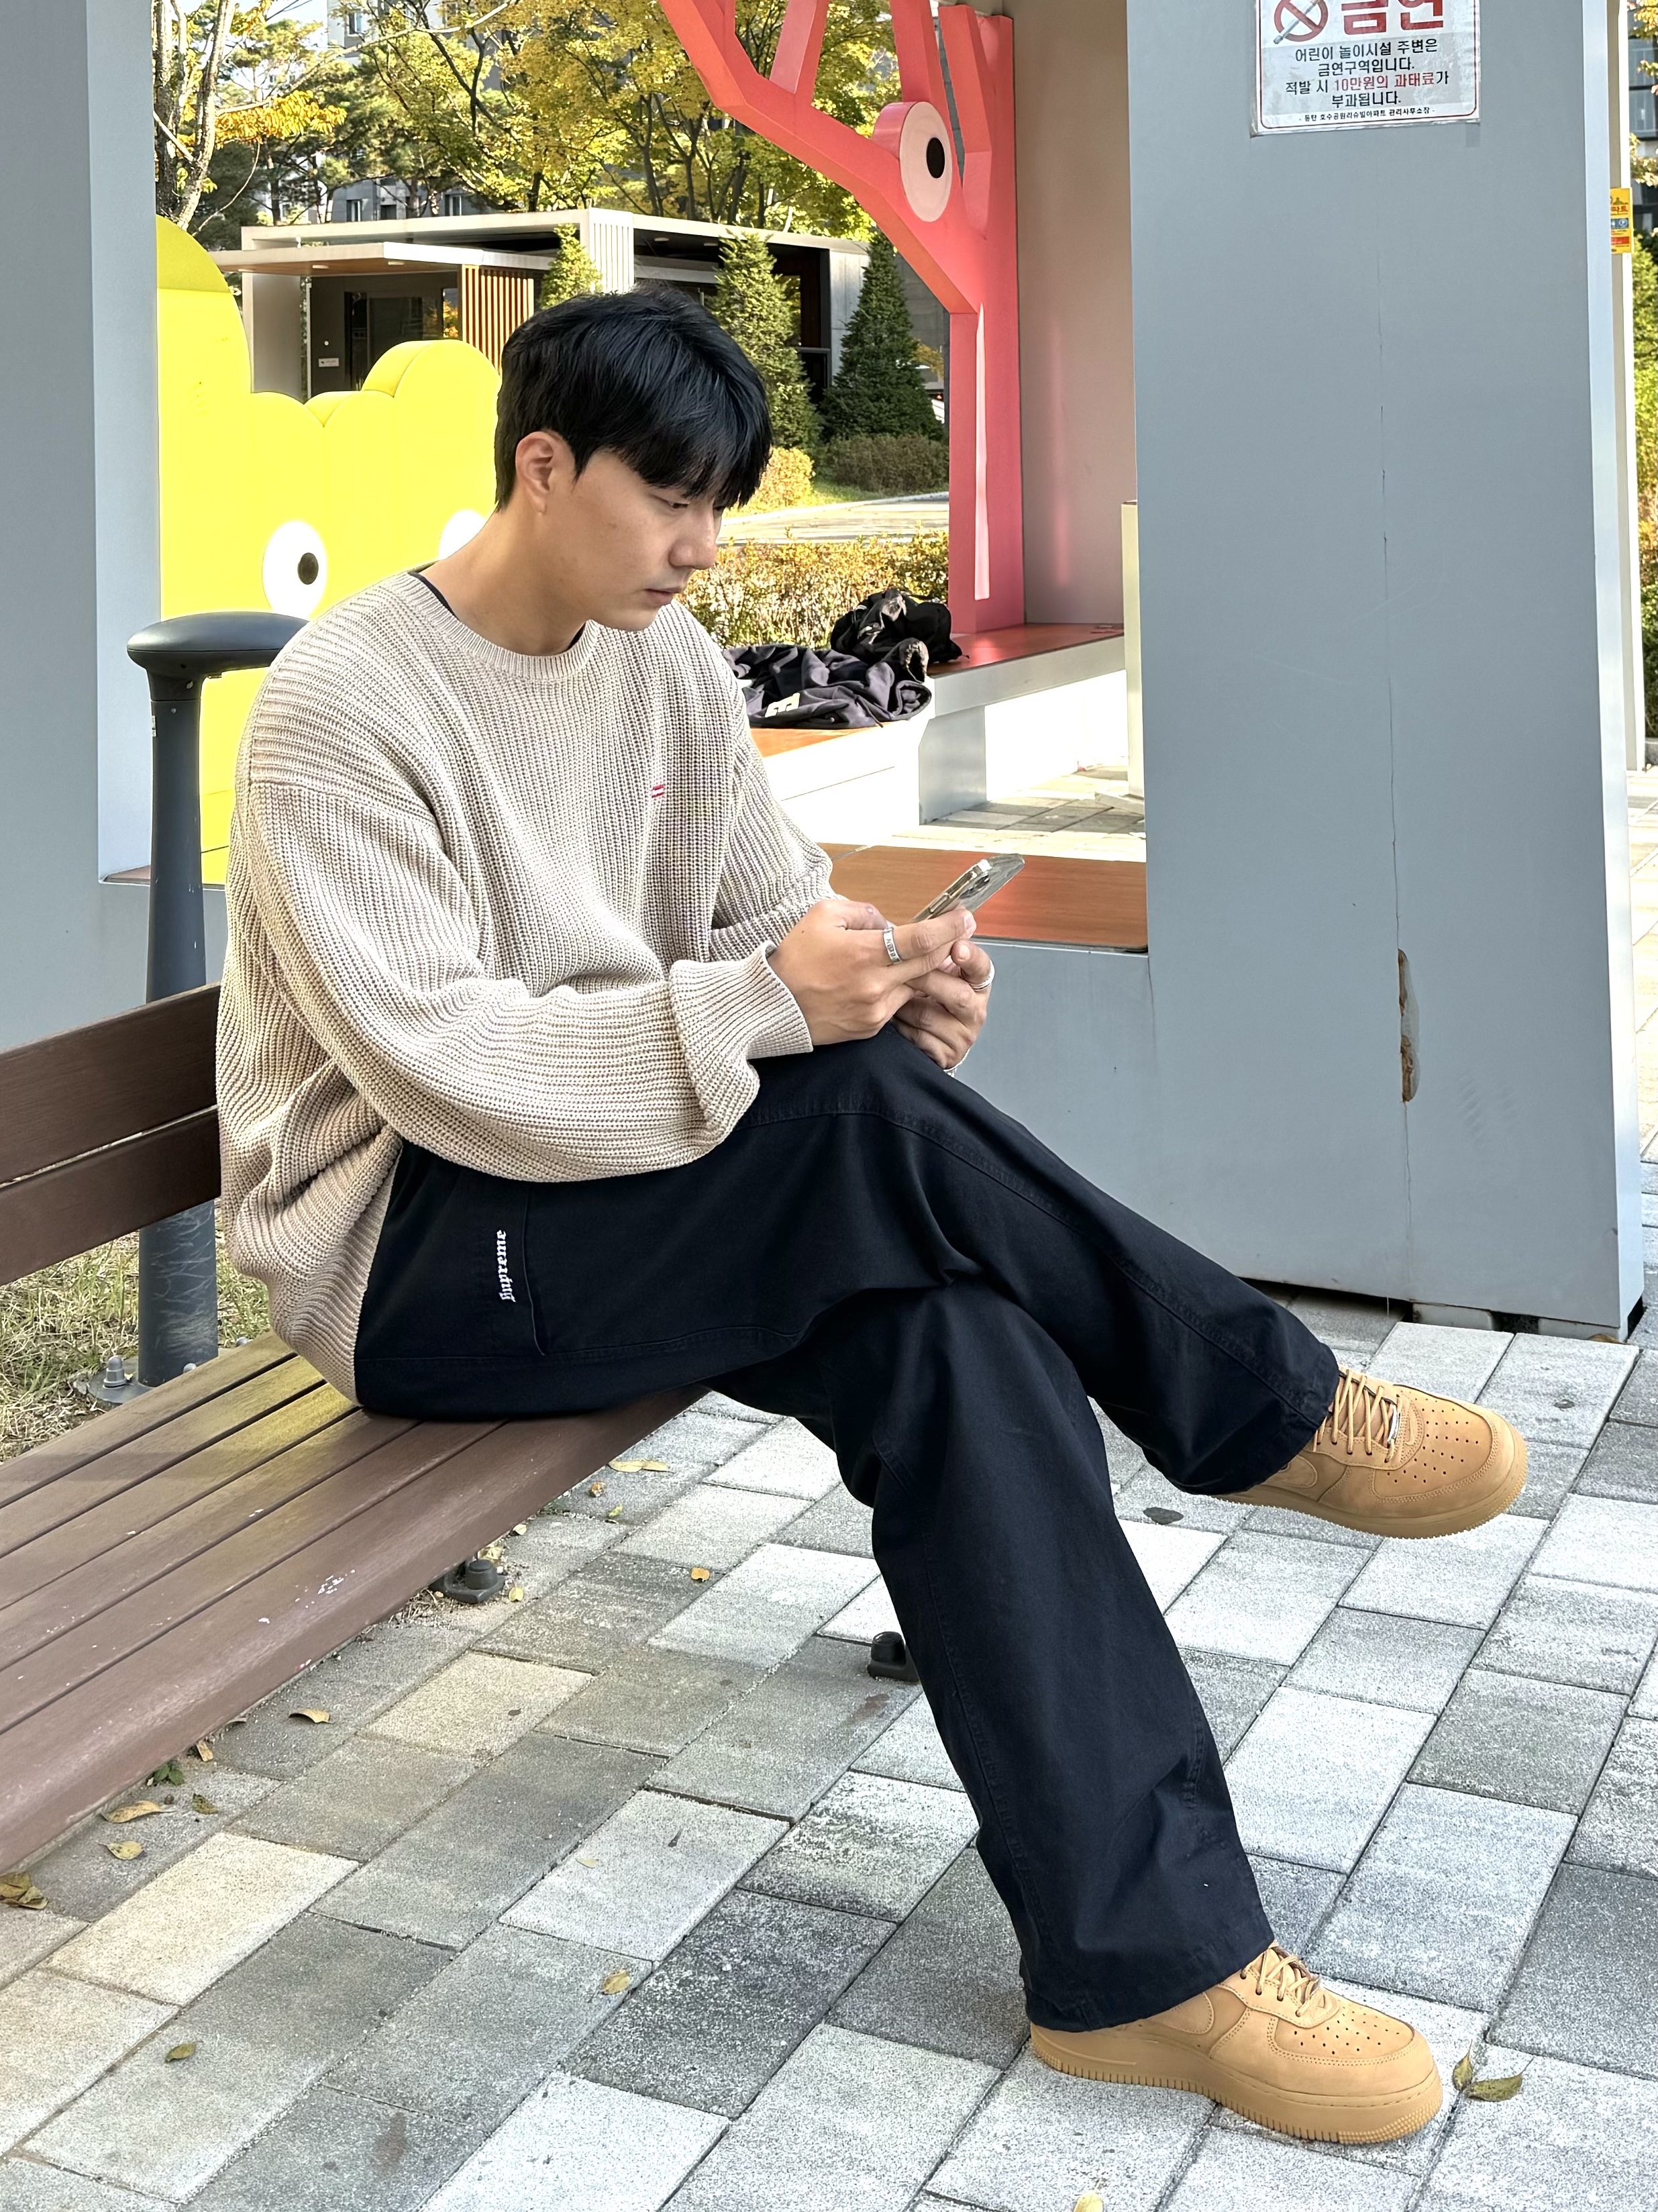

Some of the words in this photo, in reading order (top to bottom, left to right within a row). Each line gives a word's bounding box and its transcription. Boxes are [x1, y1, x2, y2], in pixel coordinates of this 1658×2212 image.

[1341, 0, 1443, 35] 금연
[1295, 46, 1333, 62] 어린이
[1339, 42, 1392, 58] 놀이시설
[1398, 38, 1437, 54] 주변은
[1318, 57, 1415, 77] 금연구역입니다.
[1286, 81, 1310, 95] 적발
[1316, 79, 1328, 93] 시
[1335, 74, 1388, 91] 10만원의
[1395, 71, 1449, 87] 과태료가
[1332, 91, 1401, 108] 부과됩니다.
[1389, 107, 1429, 116] 관리사무소장
[497, 1229, 515, 1302] Supreme
